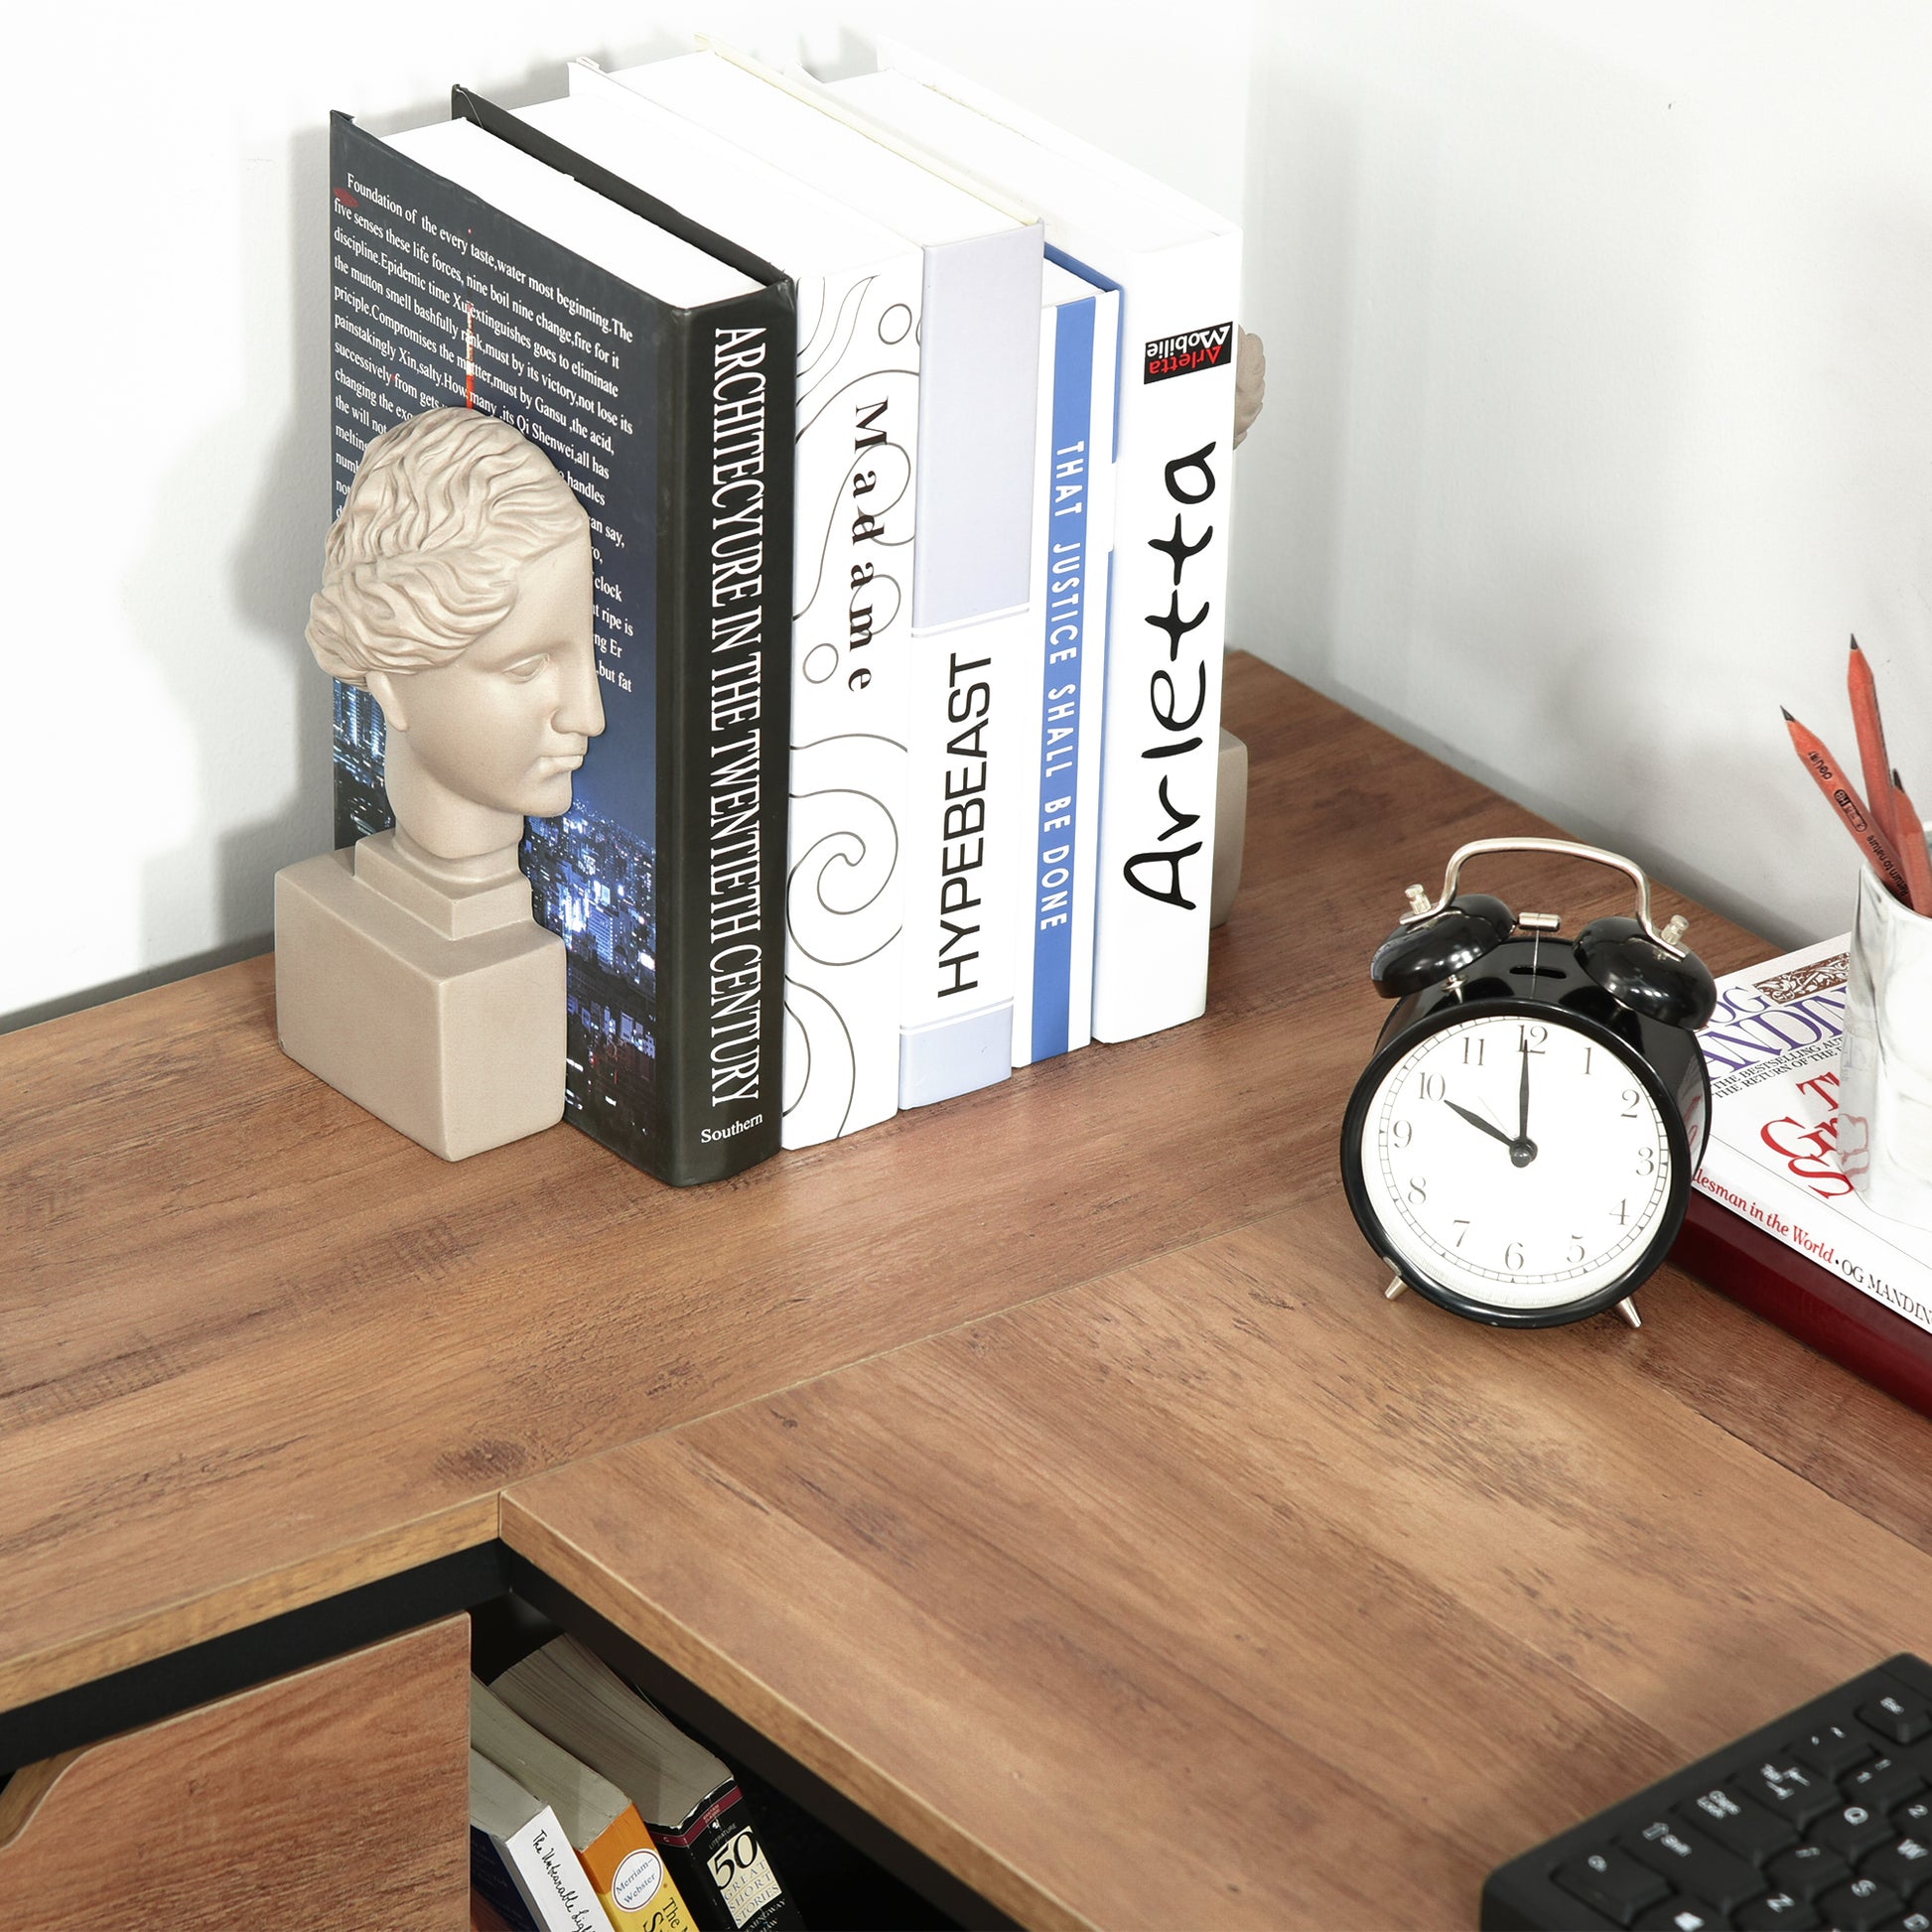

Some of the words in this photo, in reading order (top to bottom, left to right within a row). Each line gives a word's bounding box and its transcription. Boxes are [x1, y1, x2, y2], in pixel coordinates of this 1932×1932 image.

[347, 173, 402, 216] Foundation
[405, 208, 417, 223] of
[421, 215, 437, 235] the
[440, 228, 468, 255] every
[528, 276, 554, 300] most
[335, 198, 351, 219] five
[354, 212, 383, 238] senses
[386, 228, 410, 253] these
[413, 241, 429, 263] life
[432, 253, 464, 286] forces,
[467, 275, 488, 296] nine
[490, 284, 509, 308] boil
[512, 300, 534, 322] nine
[594, 343, 610, 362] for
[612, 351, 620, 368] it
[335, 255, 348, 274] the
[350, 267, 383, 295] mutton
[385, 288, 412, 311] smell
[414, 299, 458, 340] bashfully
[511, 353, 524, 376] by
[527, 362, 539, 382] its
[598, 402, 618, 426] lose
[621, 414, 633, 435] its
[428, 280, 451, 304] time
[533, 342, 557, 362] goes
[559, 353, 570, 369] to
[571, 361, 619, 397] eliminate
[1149, 345, 1222, 374] Arletta
[335, 314, 396, 360] painstakingly
[516, 415, 529, 434] Qi
[593, 457, 610, 480] has
[336, 395, 349, 413] the
[351, 405, 369, 427] will
[372, 419, 386, 435] not
[439, 344, 454, 362] the
[457, 356, 521, 399] mtter,must
[519, 386, 532, 409] by
[534, 397, 567, 426] Gansu
[590, 431, 615, 456] acid,
[335, 342, 391, 386] successively
[394, 373, 417, 398] from
[567, 471, 606, 506] handles
[336, 368, 377, 406] changing
[378, 393, 394, 413] the
[590, 517, 603, 533] an
[605, 526, 624, 548] say,
[711, 328, 766, 608] ARCHITECYURE
[1054, 440, 1085, 517] THAT
[594, 576, 622, 602] clock
[1049, 542, 1081, 665] JUSTICE
[602, 608, 622, 629] ripe
[624, 619, 633, 636] is
[711, 605, 761, 653] IN
[594, 633, 607, 653] ng
[610, 638, 622, 658] Er
[618, 672, 632, 692] fat
[711, 651, 761, 733] THE
[1123, 441, 1217, 910] Arletta
[1045, 683, 1076, 778] SHALL
[937, 652, 991, 999] HYPEBEAST
[1043, 795, 1072, 833] BE
[710, 734, 761, 944] TWENTIETH
[1865, 835, 1886, 861] nature
[1040, 844, 1070, 931] DONE
[710, 944, 762, 1108] CENTURY
[1516, 1025, 1548, 1054] 12
[1461, 1036, 1484, 1066] 11
[1584, 1046, 1592, 1075] 1
[1712, 1073, 1740, 1090] THE
[1738, 1045, 1821, 1079] BESTSELLING
[1822, 1036, 1844, 1049] AUT
[1745, 1063, 1793, 1088] RETURN
[1791, 1056, 1808, 1068] OF
[1807, 1048, 1838, 1063] THE
[1418, 1071, 1446, 1101] 10
[1620, 1089, 1640, 1119] 2
[700, 1112, 763, 1144] Southern
[1393, 1120, 1413, 1149] 9
[1635, 1147, 1654, 1175] 3
[1407, 1175, 1427, 1204] 8
[1608, 1198, 1630, 1226] 4
[1453, 1219, 1470, 1248] 7
[1567, 1234, 1585, 1263] 5
[1692, 1169, 1747, 1212] lesman
[1749, 1202, 1764, 1222] in
[1766, 1214, 1789, 1236] the
[1793, 1225, 1835, 1264] World
[1842, 1259, 1863, 1283] OG
[1867, 1274, 1932, 1324] MANDIN
[1504, 1242, 1524, 1271] 6
[532, 1829, 548, 1855] The
[541, 1847, 579, 1913] Unbearable
[715, 1831, 758, 1889] 50
[622, 1872, 656, 1905] Webster
[724, 1860, 766, 1901] GREAT
[730, 1871, 771, 1912] SHORT
[662, 1897, 681, 1929] The
[735, 1886, 779, 1925] STORIES
